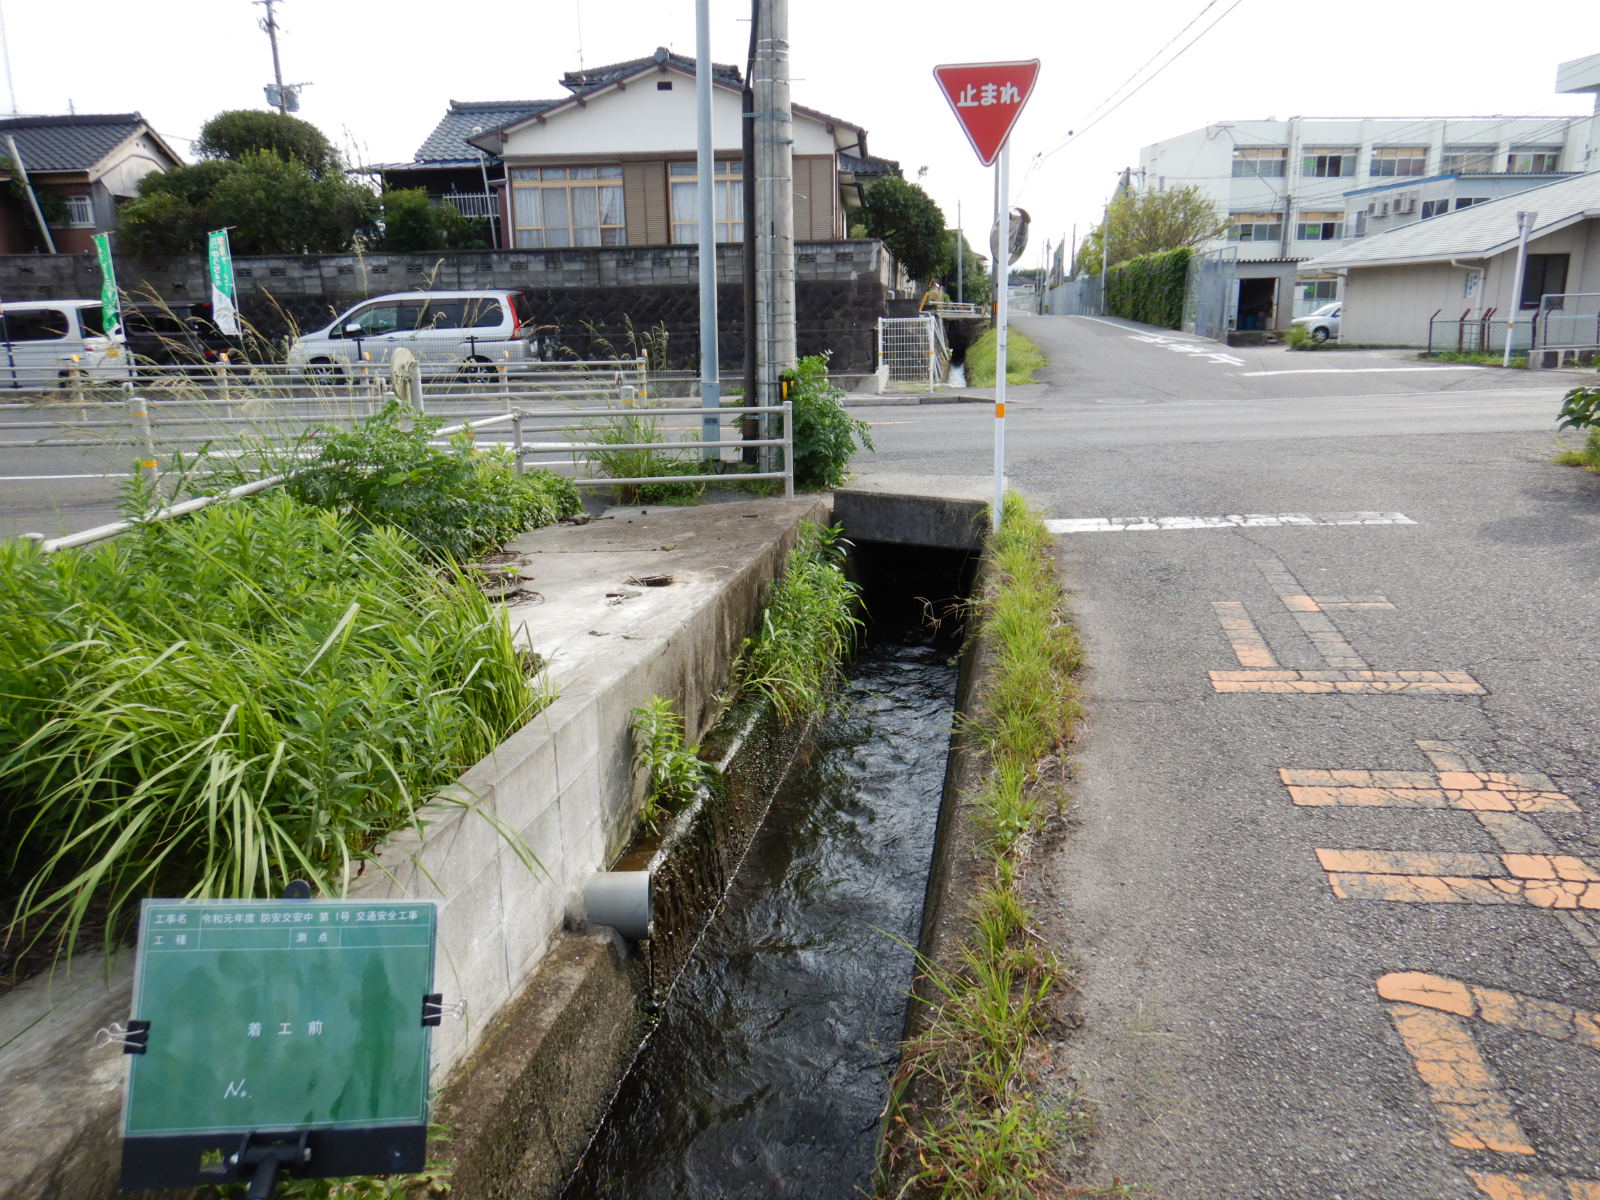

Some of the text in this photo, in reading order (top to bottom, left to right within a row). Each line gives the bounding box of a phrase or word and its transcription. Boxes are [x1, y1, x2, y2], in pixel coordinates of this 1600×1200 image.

[957, 81, 1021, 107] 止まれ
[154, 912, 187, 925] 工事名
[202, 912, 255, 925] 令和元年度
[355, 909, 418, 921] 交通安全工事
